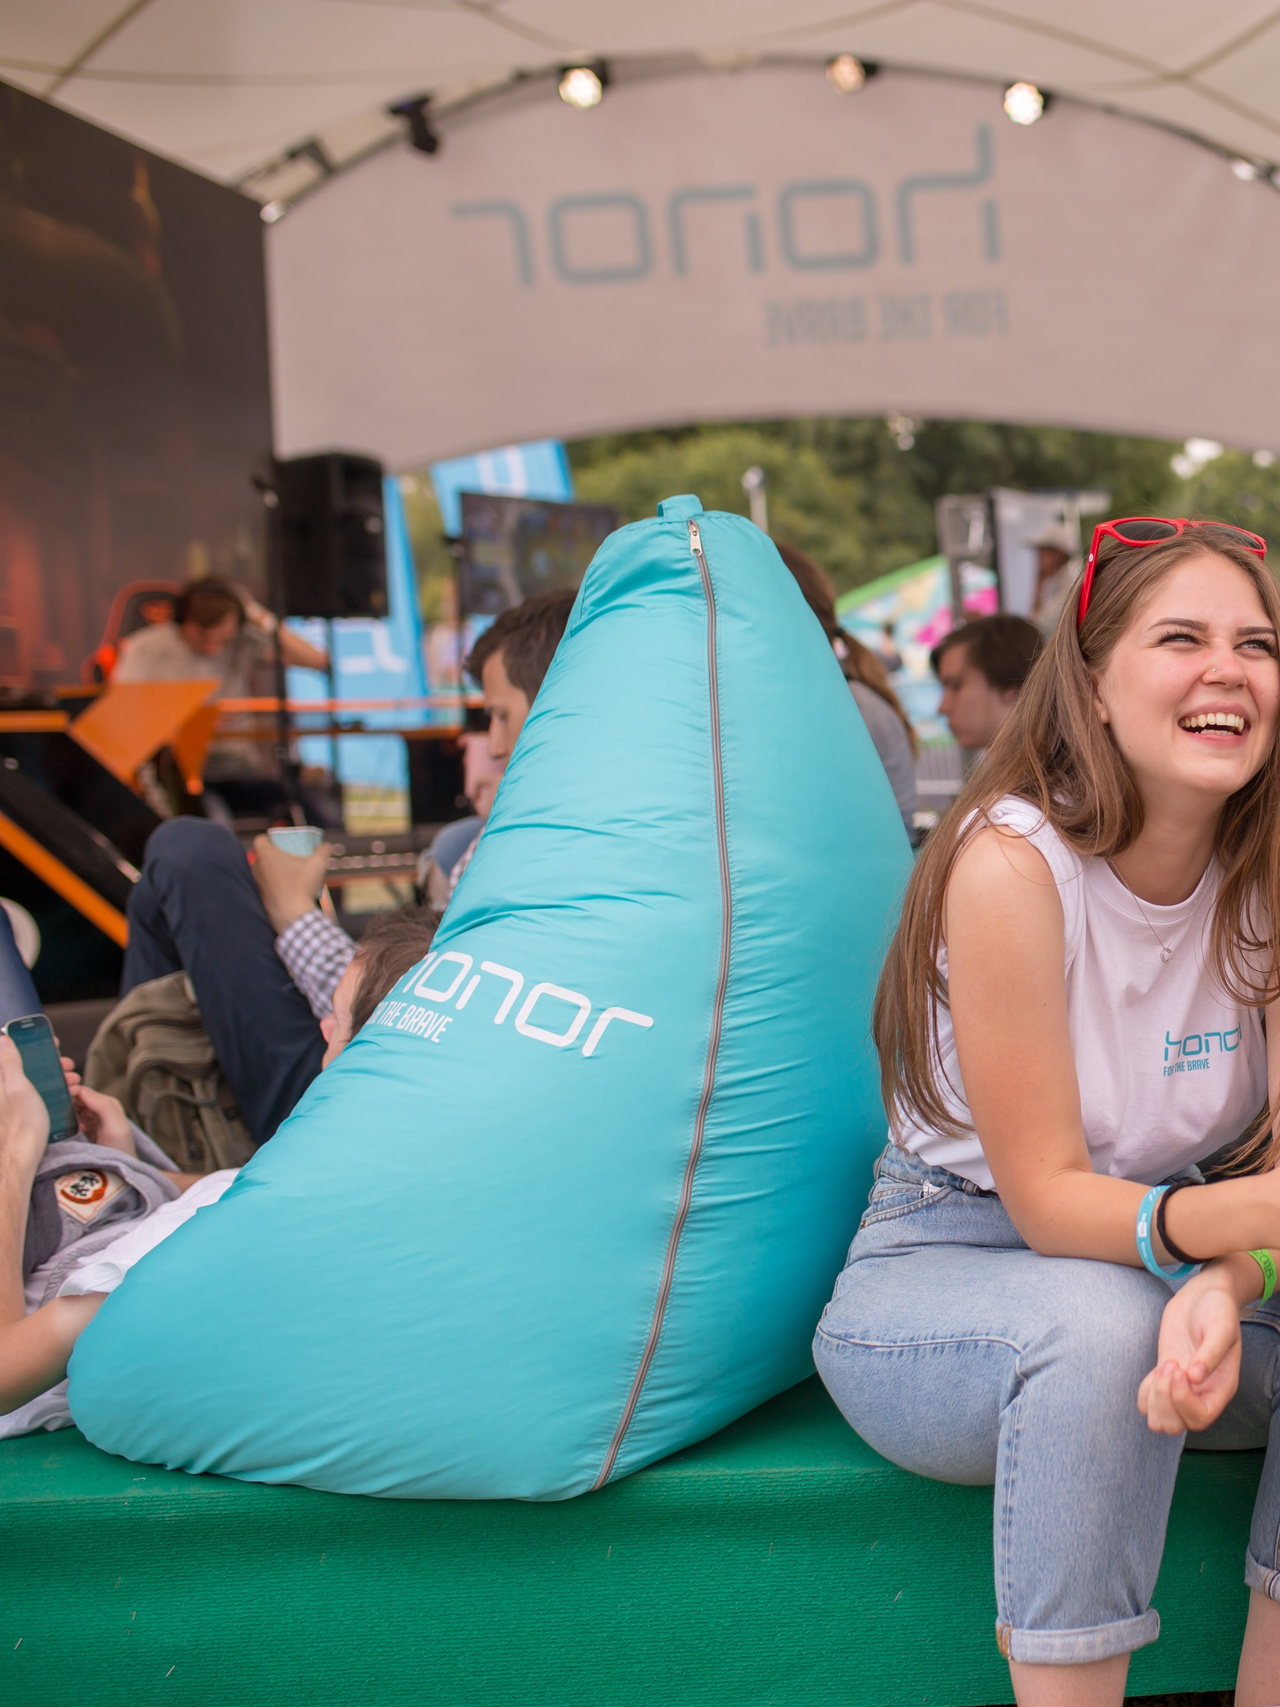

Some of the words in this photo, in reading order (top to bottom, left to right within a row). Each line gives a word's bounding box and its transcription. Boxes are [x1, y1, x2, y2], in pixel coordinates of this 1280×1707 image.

[377, 1001, 407, 1027] THE
[396, 1004, 453, 1043] BRAVE
[1164, 1021, 1242, 1061] hono
[1174, 1061, 1185, 1073] THE
[1187, 1058, 1210, 1071] BRAVE
